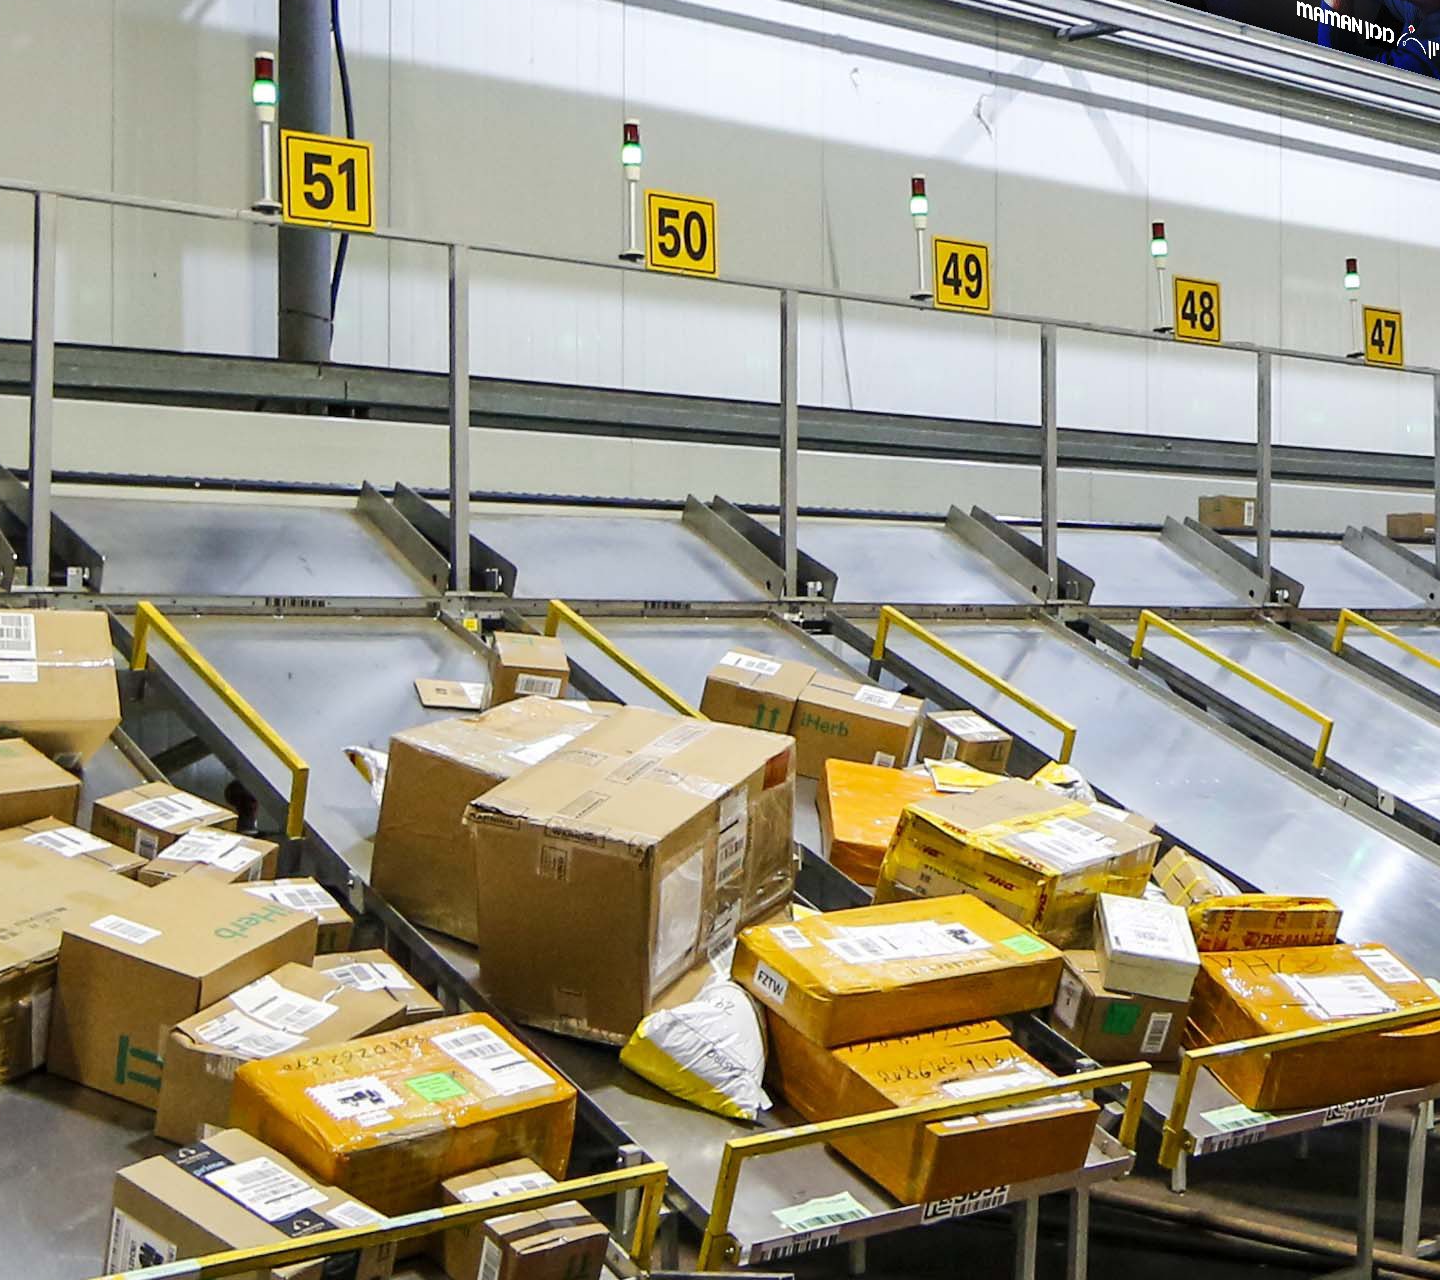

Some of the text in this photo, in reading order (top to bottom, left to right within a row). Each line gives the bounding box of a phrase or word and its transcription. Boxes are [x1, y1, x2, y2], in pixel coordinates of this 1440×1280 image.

[1296, 1, 1363, 34] MAMAN
[1365, 21, 1395, 43] ממן
[301, 152, 358, 213] 51
[656, 206, 708, 263] 50
[941, 252, 984, 300] 49
[1181, 289, 1215, 332] 48
[1370, 318, 1397, 356] 47
[800, 711, 849, 737] iHerb
[757, 970, 785, 997] FZTW
